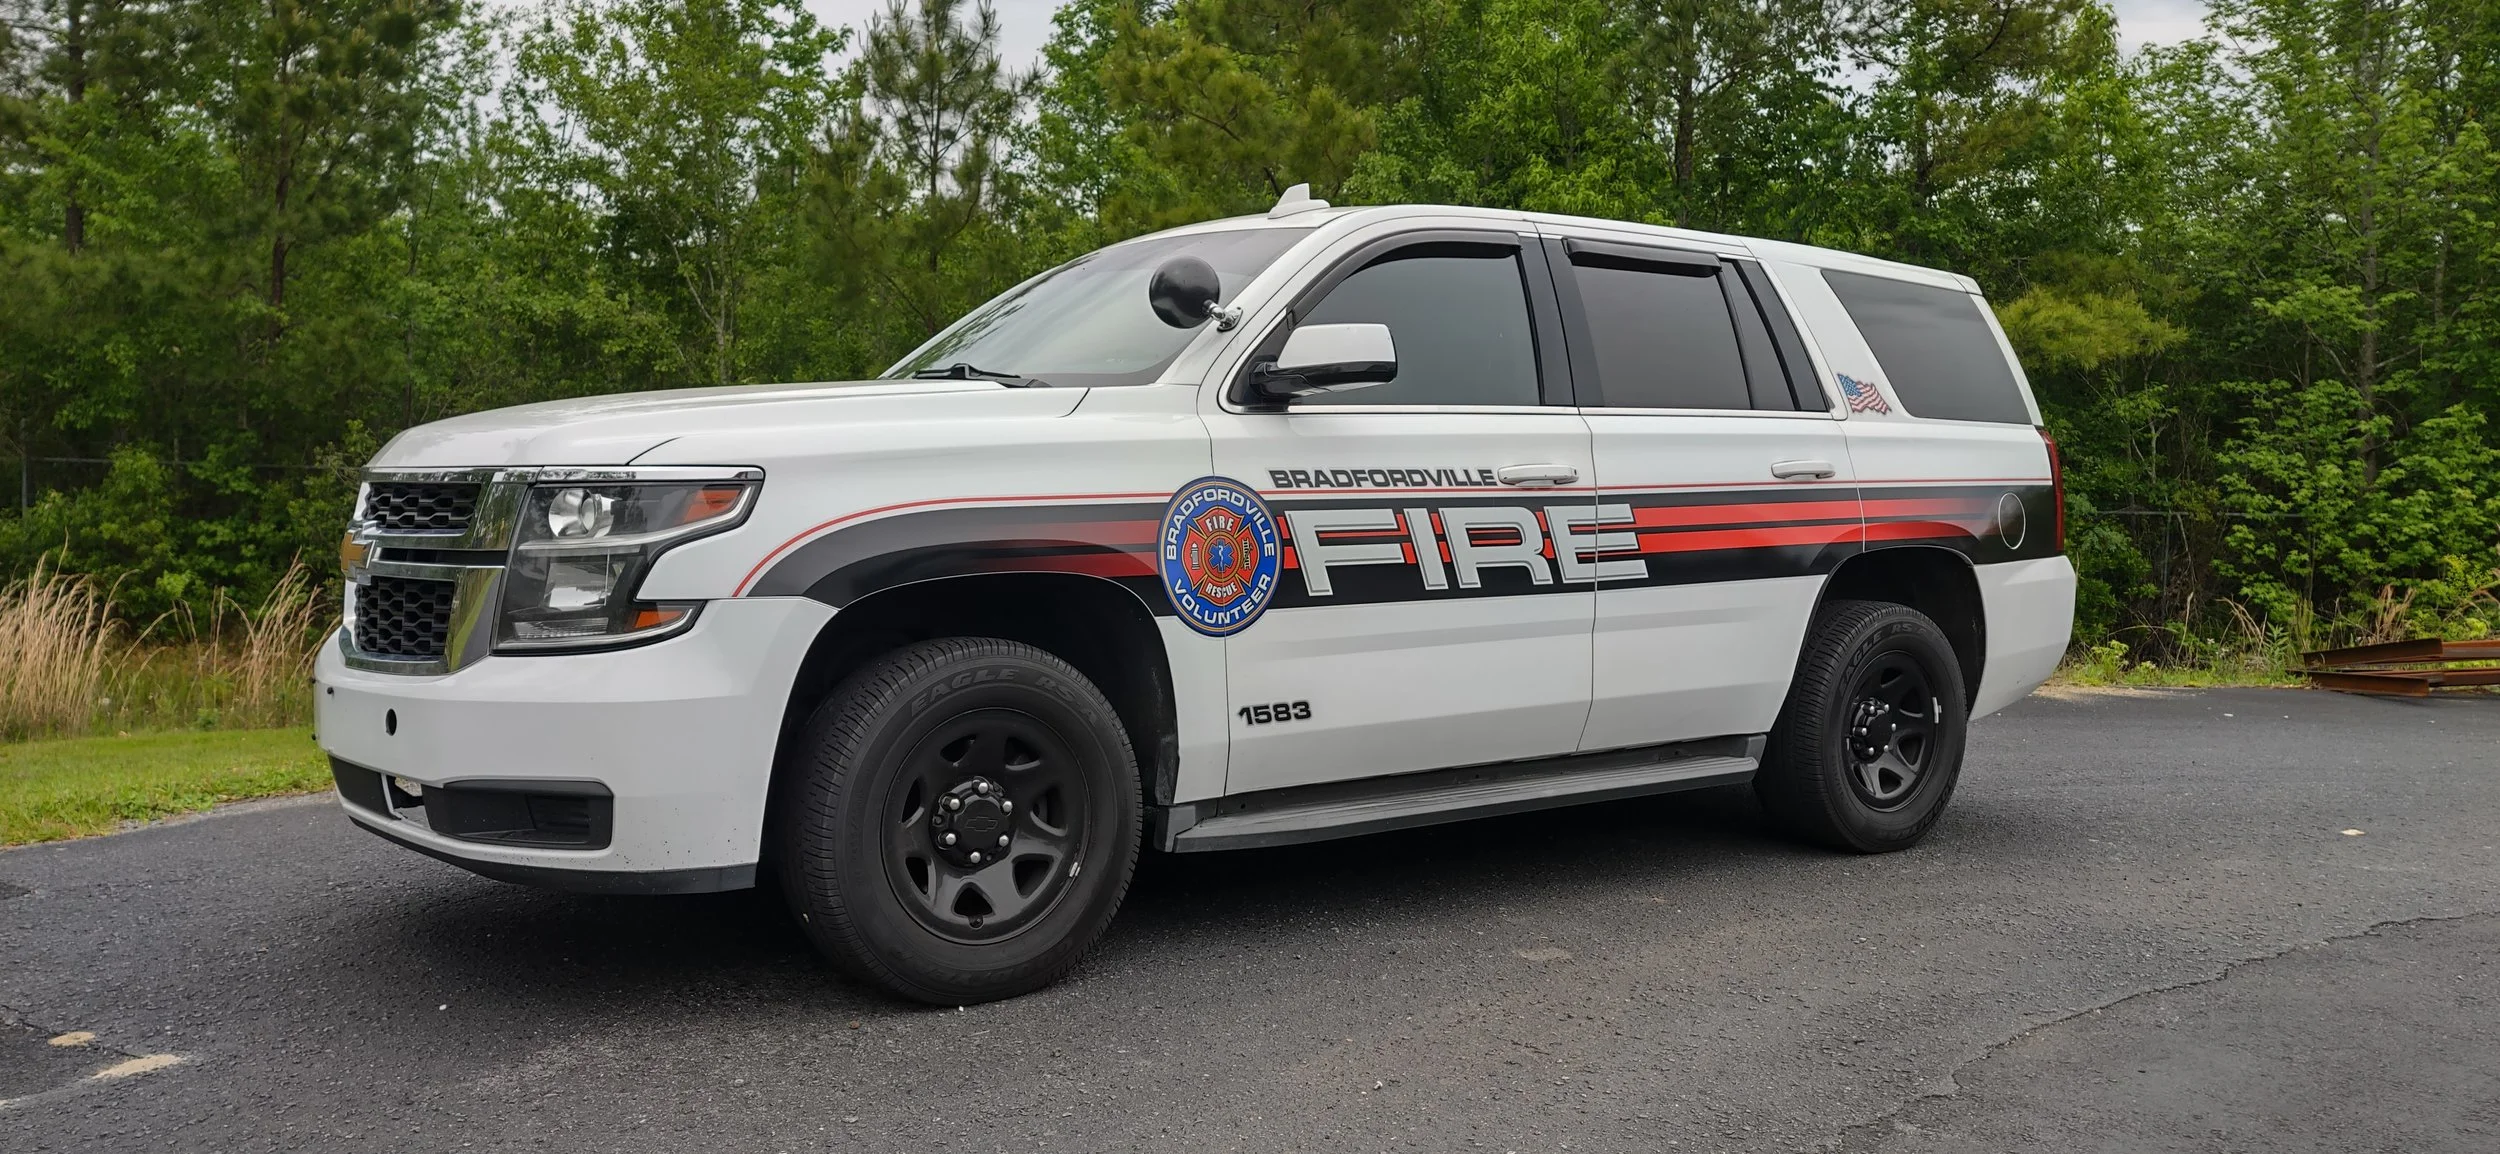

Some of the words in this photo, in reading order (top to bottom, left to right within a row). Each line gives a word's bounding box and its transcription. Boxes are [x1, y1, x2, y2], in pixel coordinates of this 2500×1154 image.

[1269, 469, 1498, 488] BRADFORDVILLE
[1166, 488, 1275, 560] BRADFORDVILLE
[1205, 514, 1234, 532] FIRE
[1284, 503, 1649, 596] FIRE
[1174, 573, 1272, 625] VOLUNTEER
[1205, 582, 1238, 598] RESCUE
[911, 668, 1020, 715] EAGLE
[1238, 701, 1311, 725] 1583
